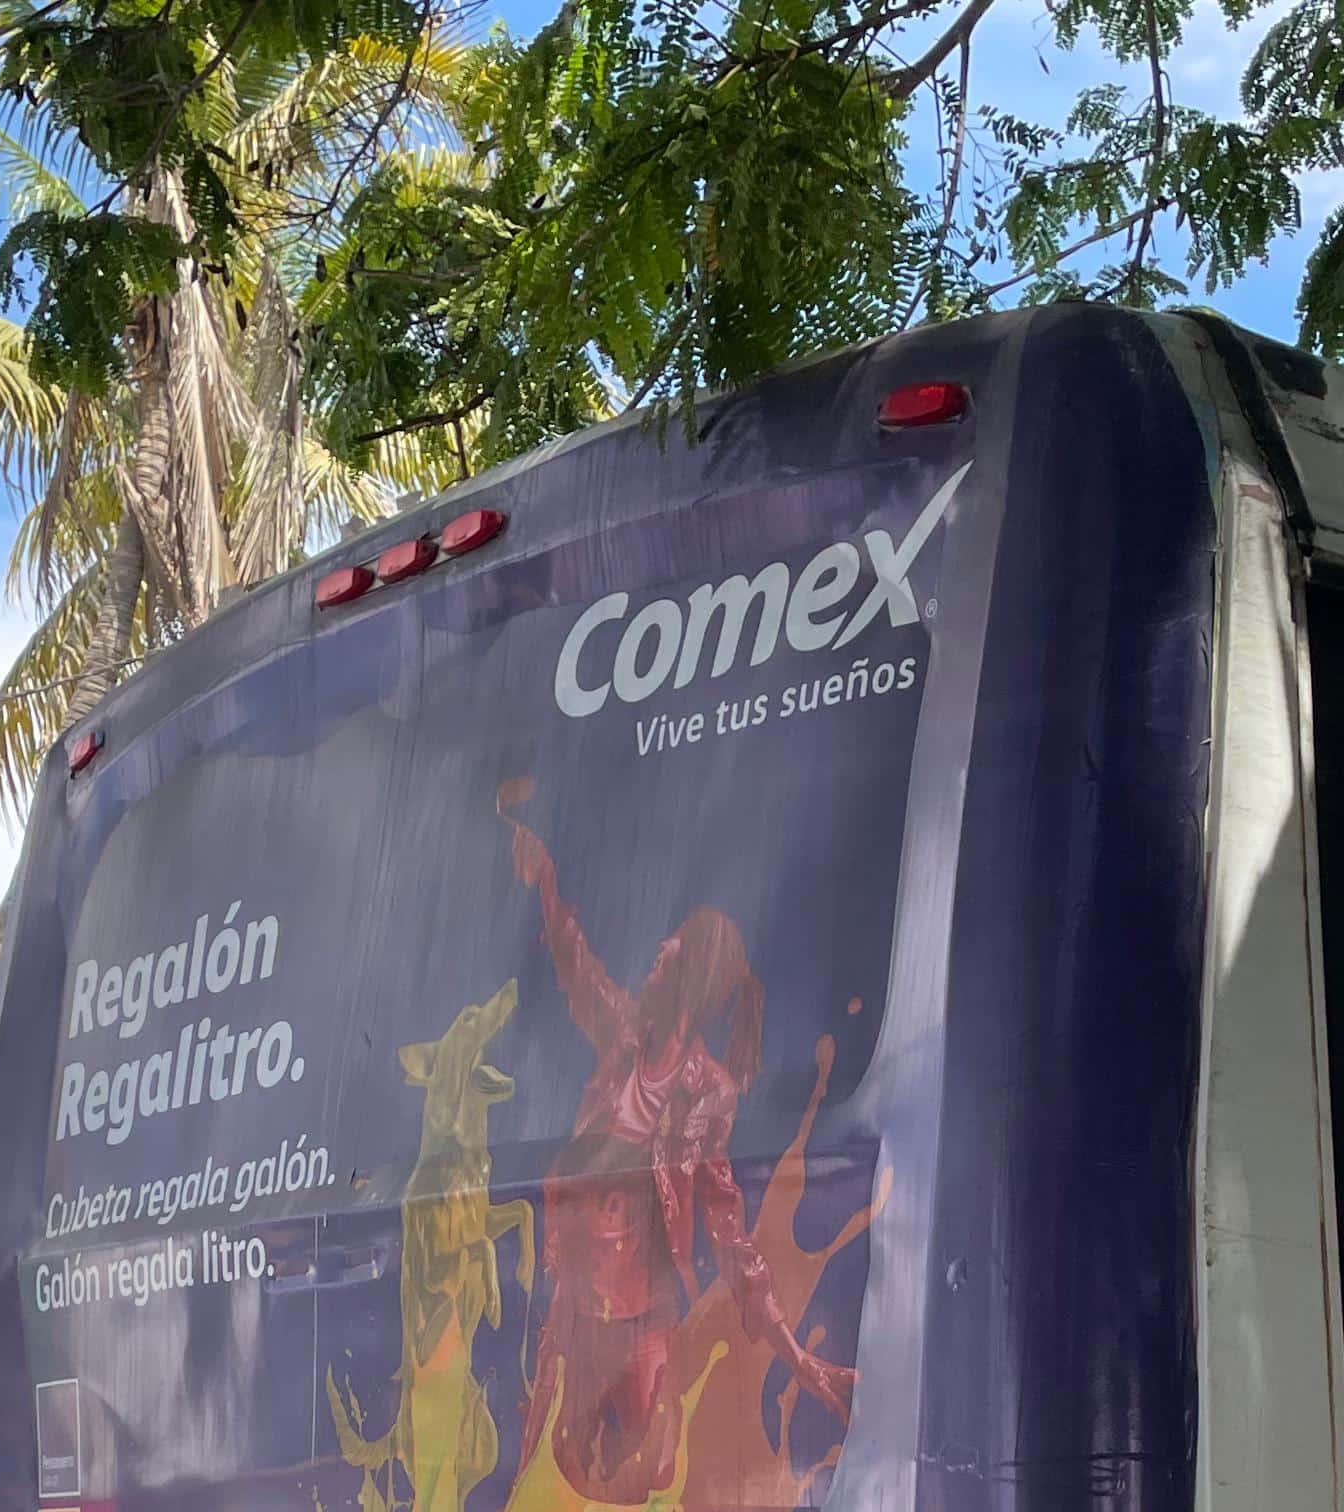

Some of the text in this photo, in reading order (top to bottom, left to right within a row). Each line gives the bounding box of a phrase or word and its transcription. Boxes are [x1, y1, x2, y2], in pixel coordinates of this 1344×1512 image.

[555, 459, 975, 718] Comex
[635, 657, 916, 757] Vive tus sueños
[68, 900, 280, 1040] Regalón
[55, 1017, 306, 1146] Regalitro.
[45, 1134, 336, 1240] Cubeta regala galón.
[35, 1230, 275, 1312] Galón regala litro.
